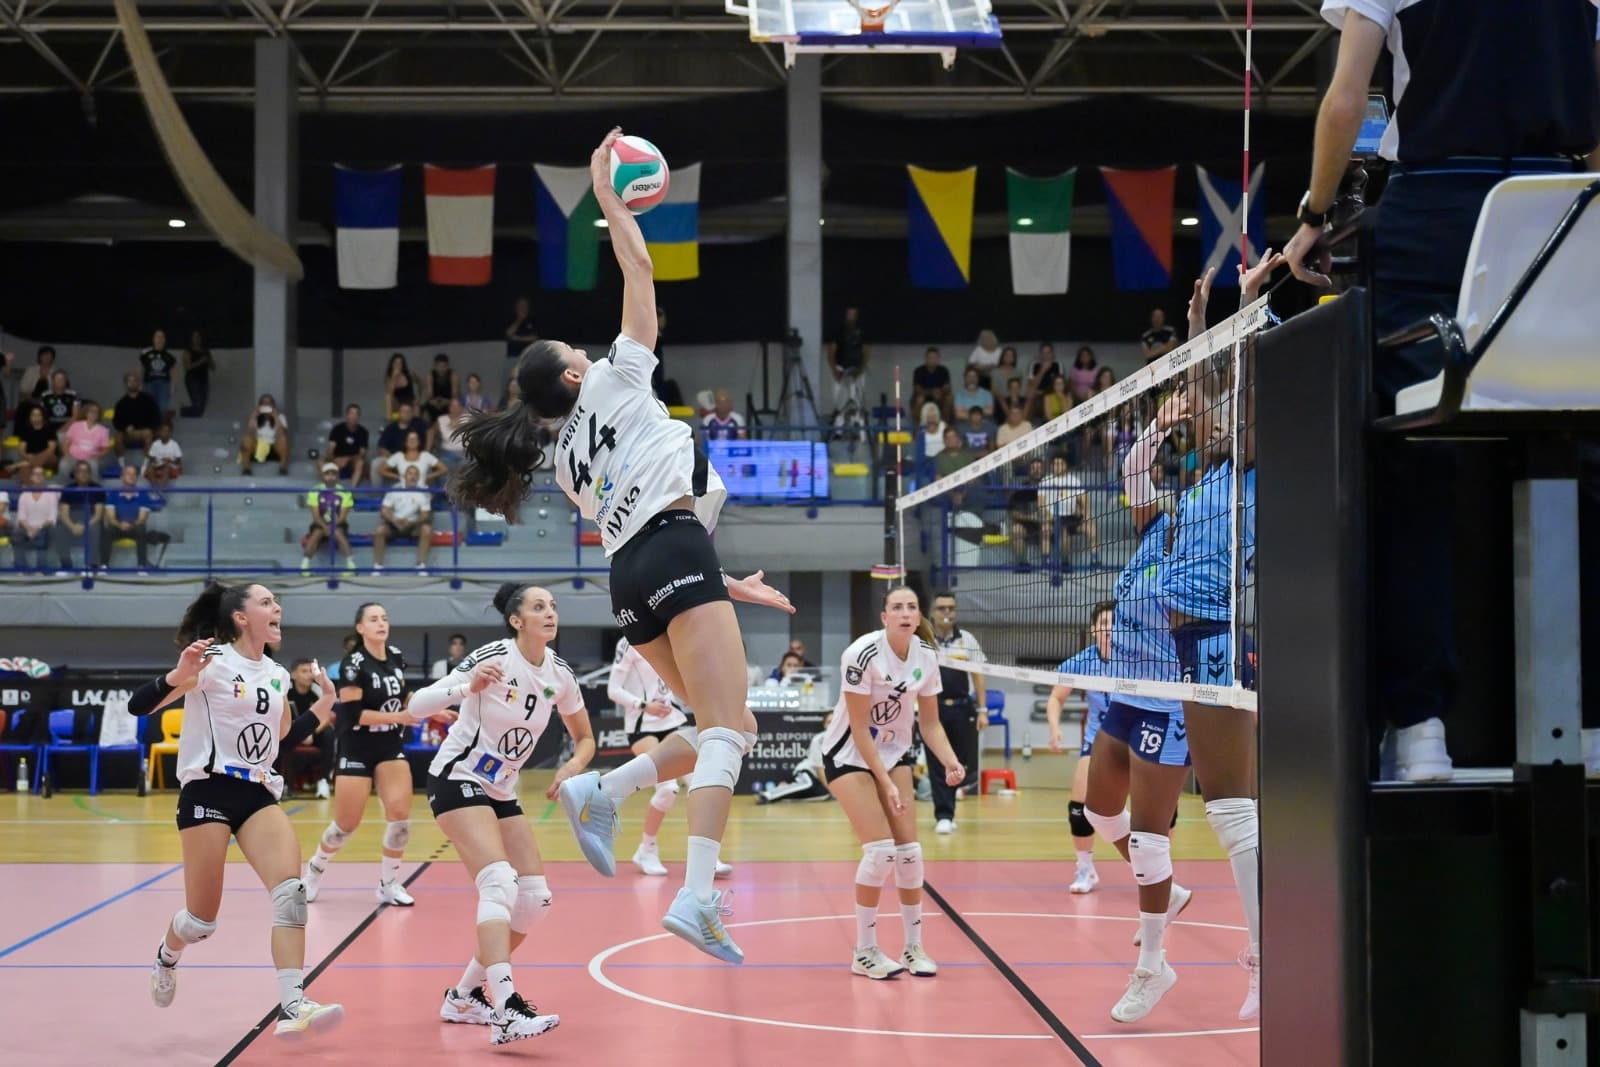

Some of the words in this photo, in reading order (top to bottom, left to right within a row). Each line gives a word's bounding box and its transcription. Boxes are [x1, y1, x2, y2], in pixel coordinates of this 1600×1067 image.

[569, 412, 616, 494] 44
[673, 573, 704, 588] Bellini
[256, 687, 270, 715] 8
[524, 693, 538, 721] 9
[748, 742, 808, 759] Heidelb
[1139, 730, 1162, 754] 19
